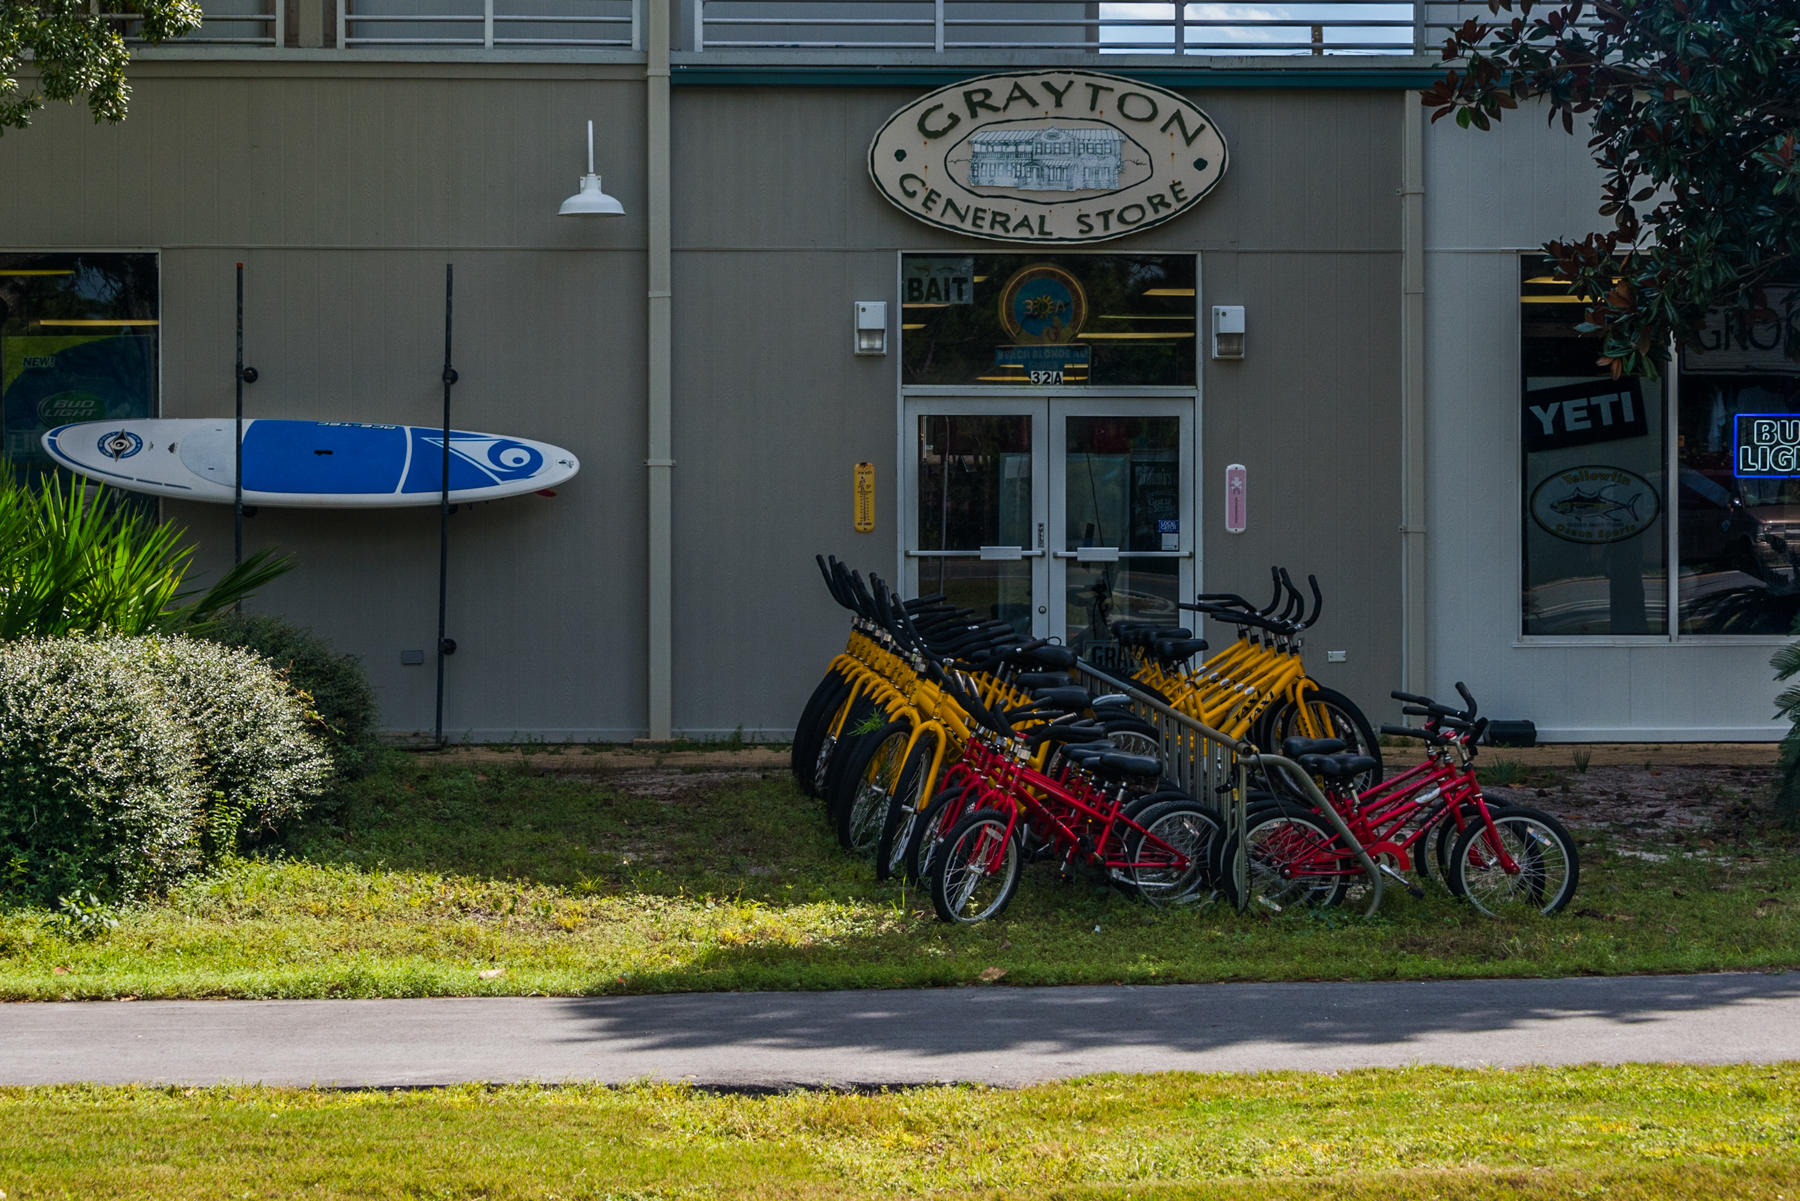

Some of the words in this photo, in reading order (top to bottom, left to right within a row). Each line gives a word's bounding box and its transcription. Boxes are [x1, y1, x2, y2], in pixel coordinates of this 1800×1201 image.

[917, 80, 1207, 147] GRAYTON
[898, 172, 1054, 237] GENERAL
[1076, 180, 1190, 235] STORE
[907, 276, 968, 303] BAIT
[1031, 371, 1063, 385] 32A
[44, 408, 97, 418] LIGHT
[53, 399, 96, 409] BUD
[1528, 390, 1636, 437] YETI
[1739, 444, 1800, 472] LIG
[1560, 470, 1632, 486] Yellowfin
